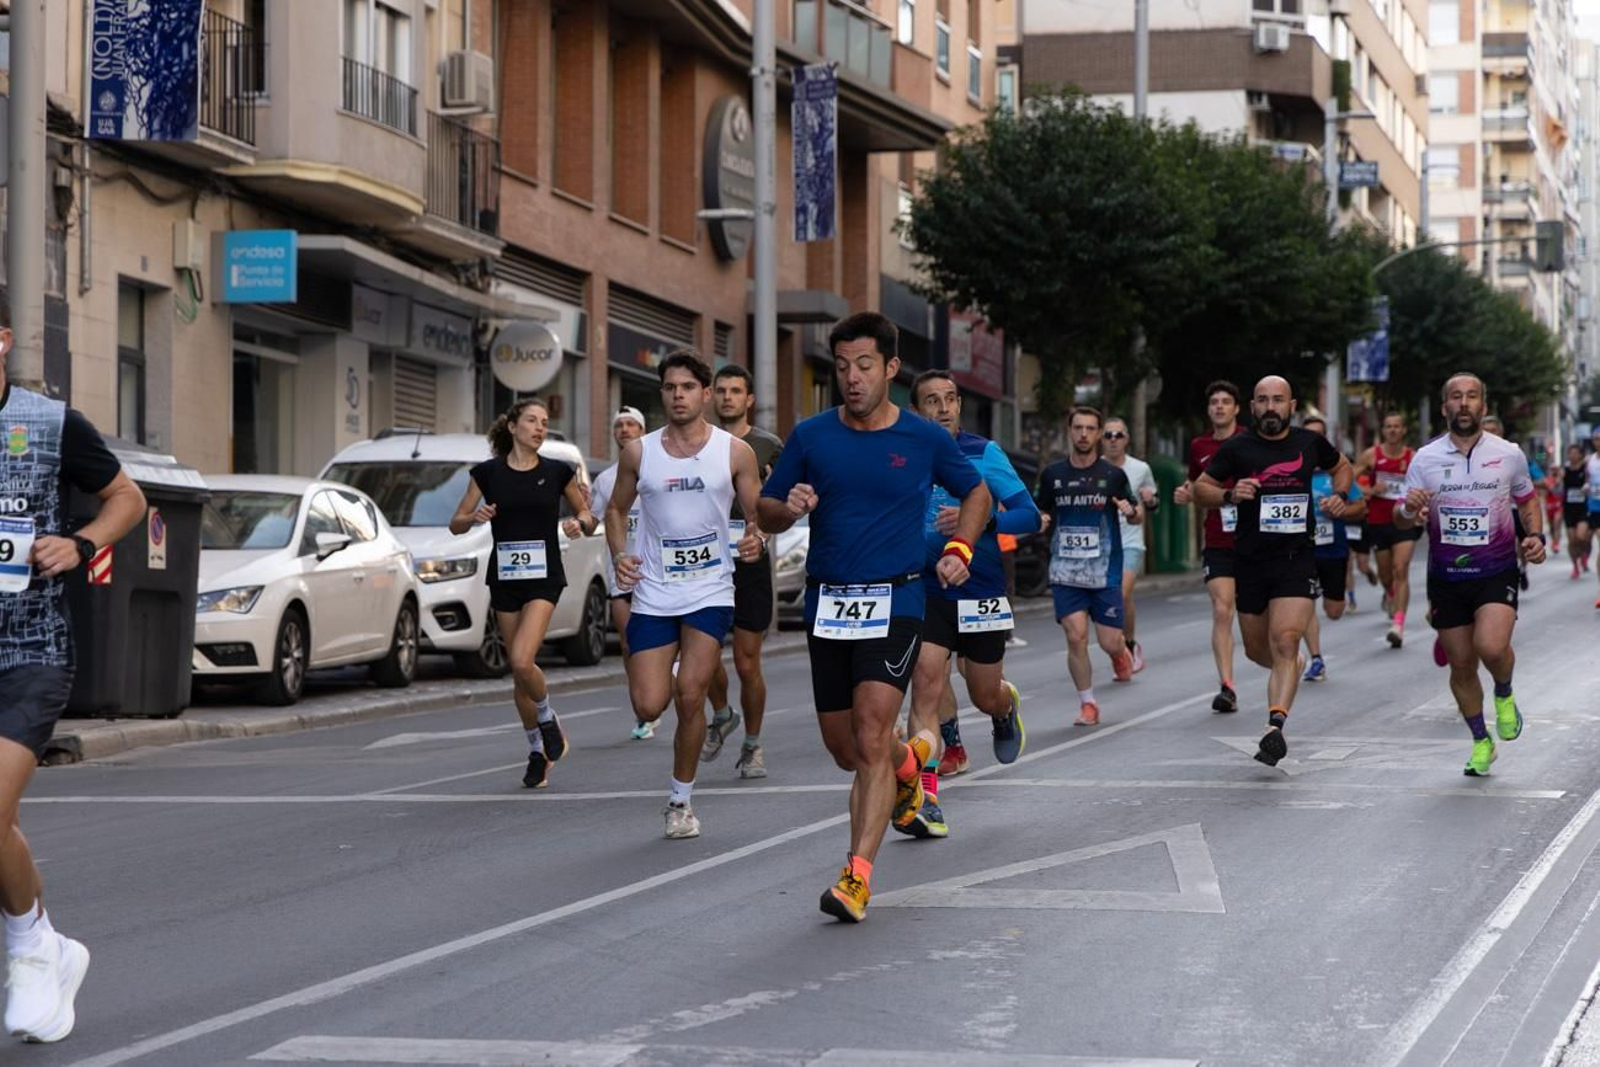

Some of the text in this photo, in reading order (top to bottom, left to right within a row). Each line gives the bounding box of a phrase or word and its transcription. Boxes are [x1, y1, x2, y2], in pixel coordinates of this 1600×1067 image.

[91, 0, 116, 80] (NOLI)
[112, 39, 125, 80] JUAN
[231, 245, 285, 259] endesa
[513, 348, 553, 362] Jucar
[666, 477, 705, 492] FILA
[1055, 493, 1107, 506] SAN ANTÓN
[1271, 505, 1300, 518] 382
[1449, 518, 1479, 530] 553
[1066, 535, 1090, 546] 631
[511, 552, 531, 565] 29
[675, 546, 711, 565] 534
[833, 601, 877, 620] 747
[978, 599, 1000, 614] 52
